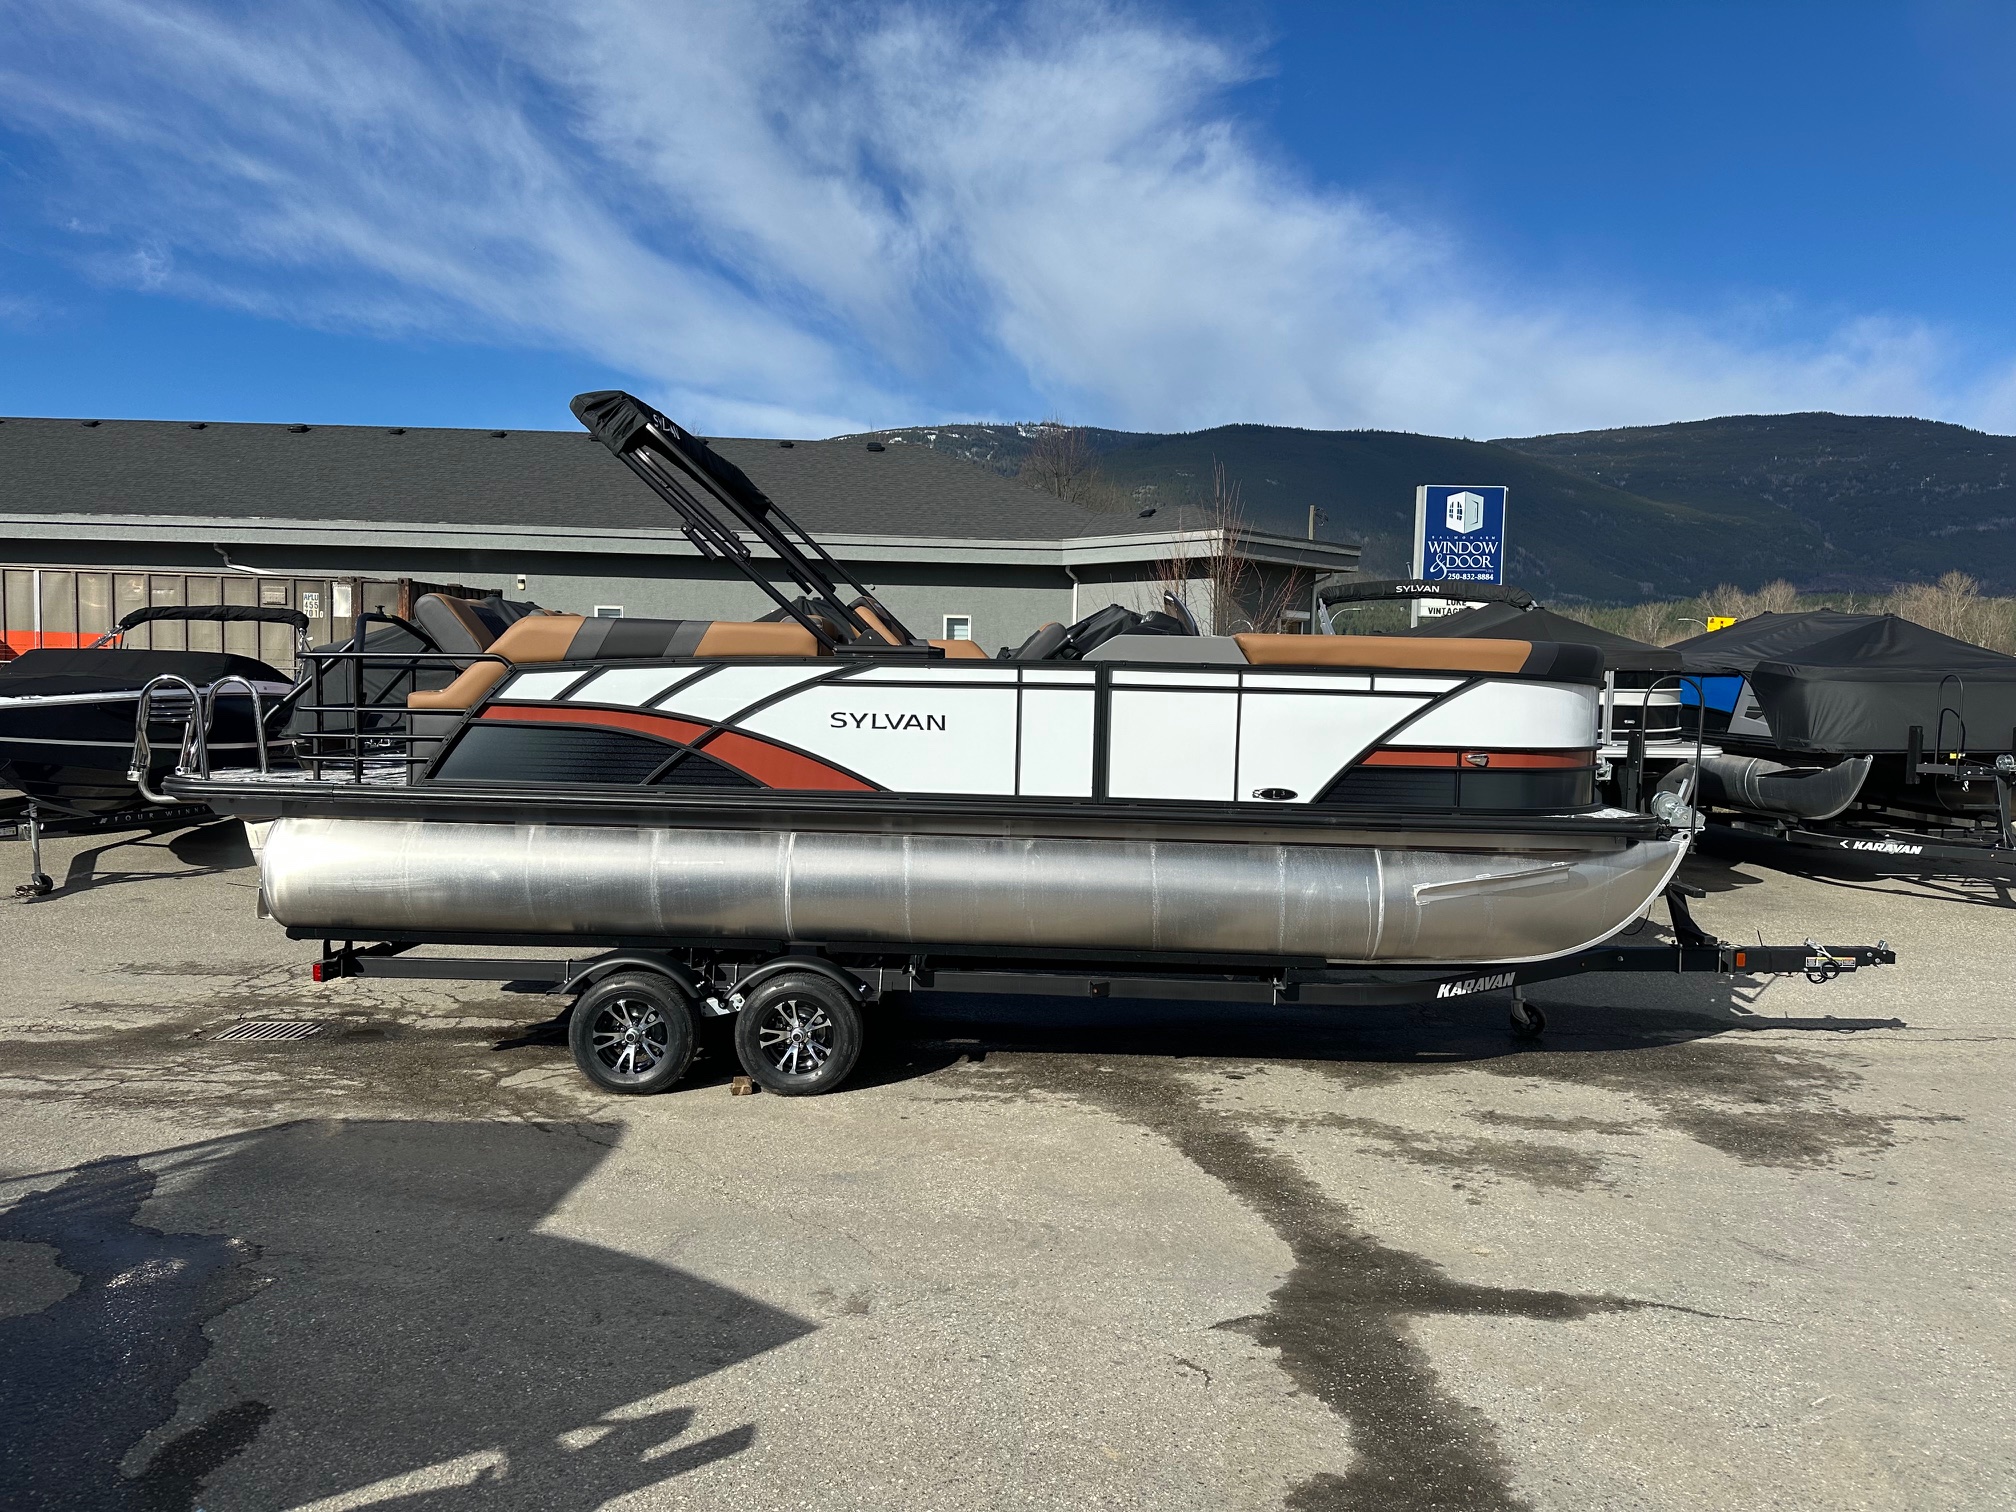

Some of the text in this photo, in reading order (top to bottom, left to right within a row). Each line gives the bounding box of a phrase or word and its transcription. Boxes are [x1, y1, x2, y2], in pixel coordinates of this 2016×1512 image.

[1428, 541, 1499, 554] WINDOW
[1395, 585, 1440, 593] SYLVAN
[304, 601, 319, 609] 455
[830, 712, 946, 731] SYLVAN
[114, 812, 154, 822] FOUR
[1852, 841, 1923, 855] KARAVAN
[1436, 971, 1516, 999] KARAVAN
